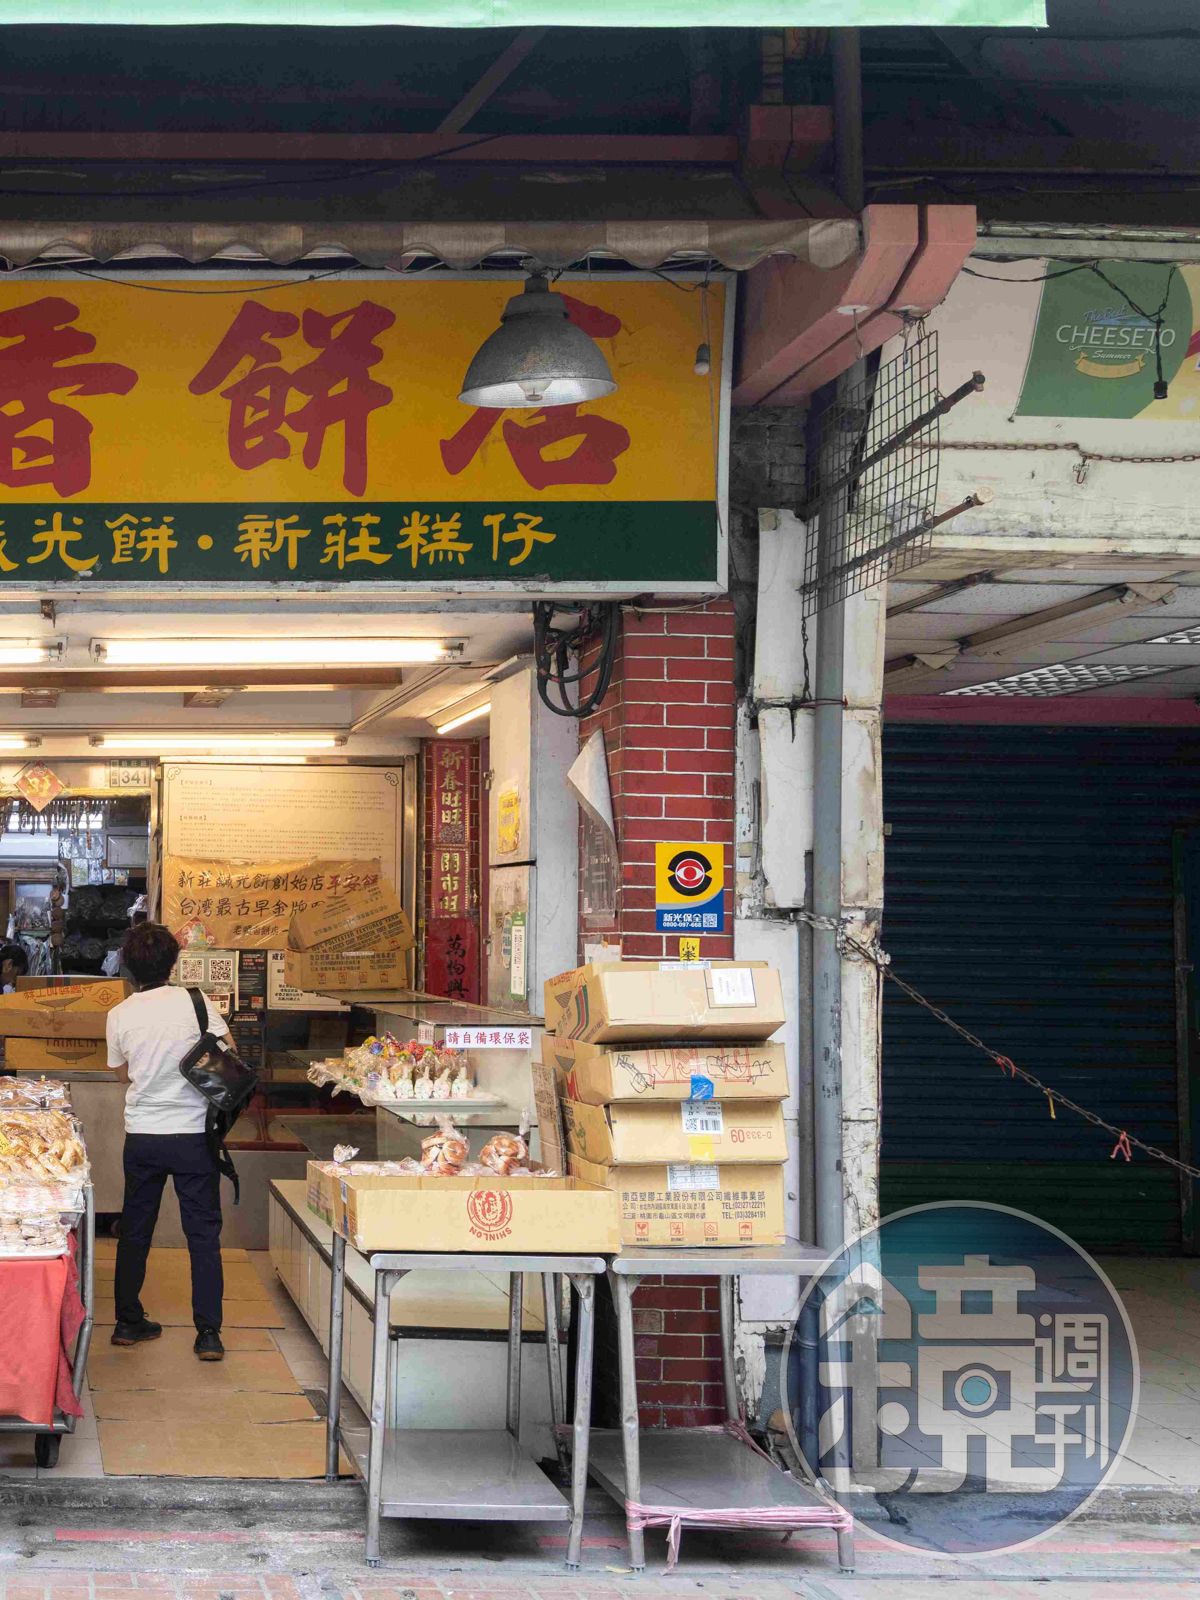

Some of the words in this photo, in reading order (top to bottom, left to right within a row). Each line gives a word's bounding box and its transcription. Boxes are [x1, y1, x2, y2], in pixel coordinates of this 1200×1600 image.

[1056, 325, 1176, 347] CHEESETO
[122, 770, 146, 784] 341
[440, 749, 464, 825] 新春旺旺
[440, 852, 460, 918] 開市旺
[663, 913, 702, 922] 新光保全
[448, 1031, 530, 1046] 請自備環保袋
[469, 1226, 512, 1241] SHINLON
